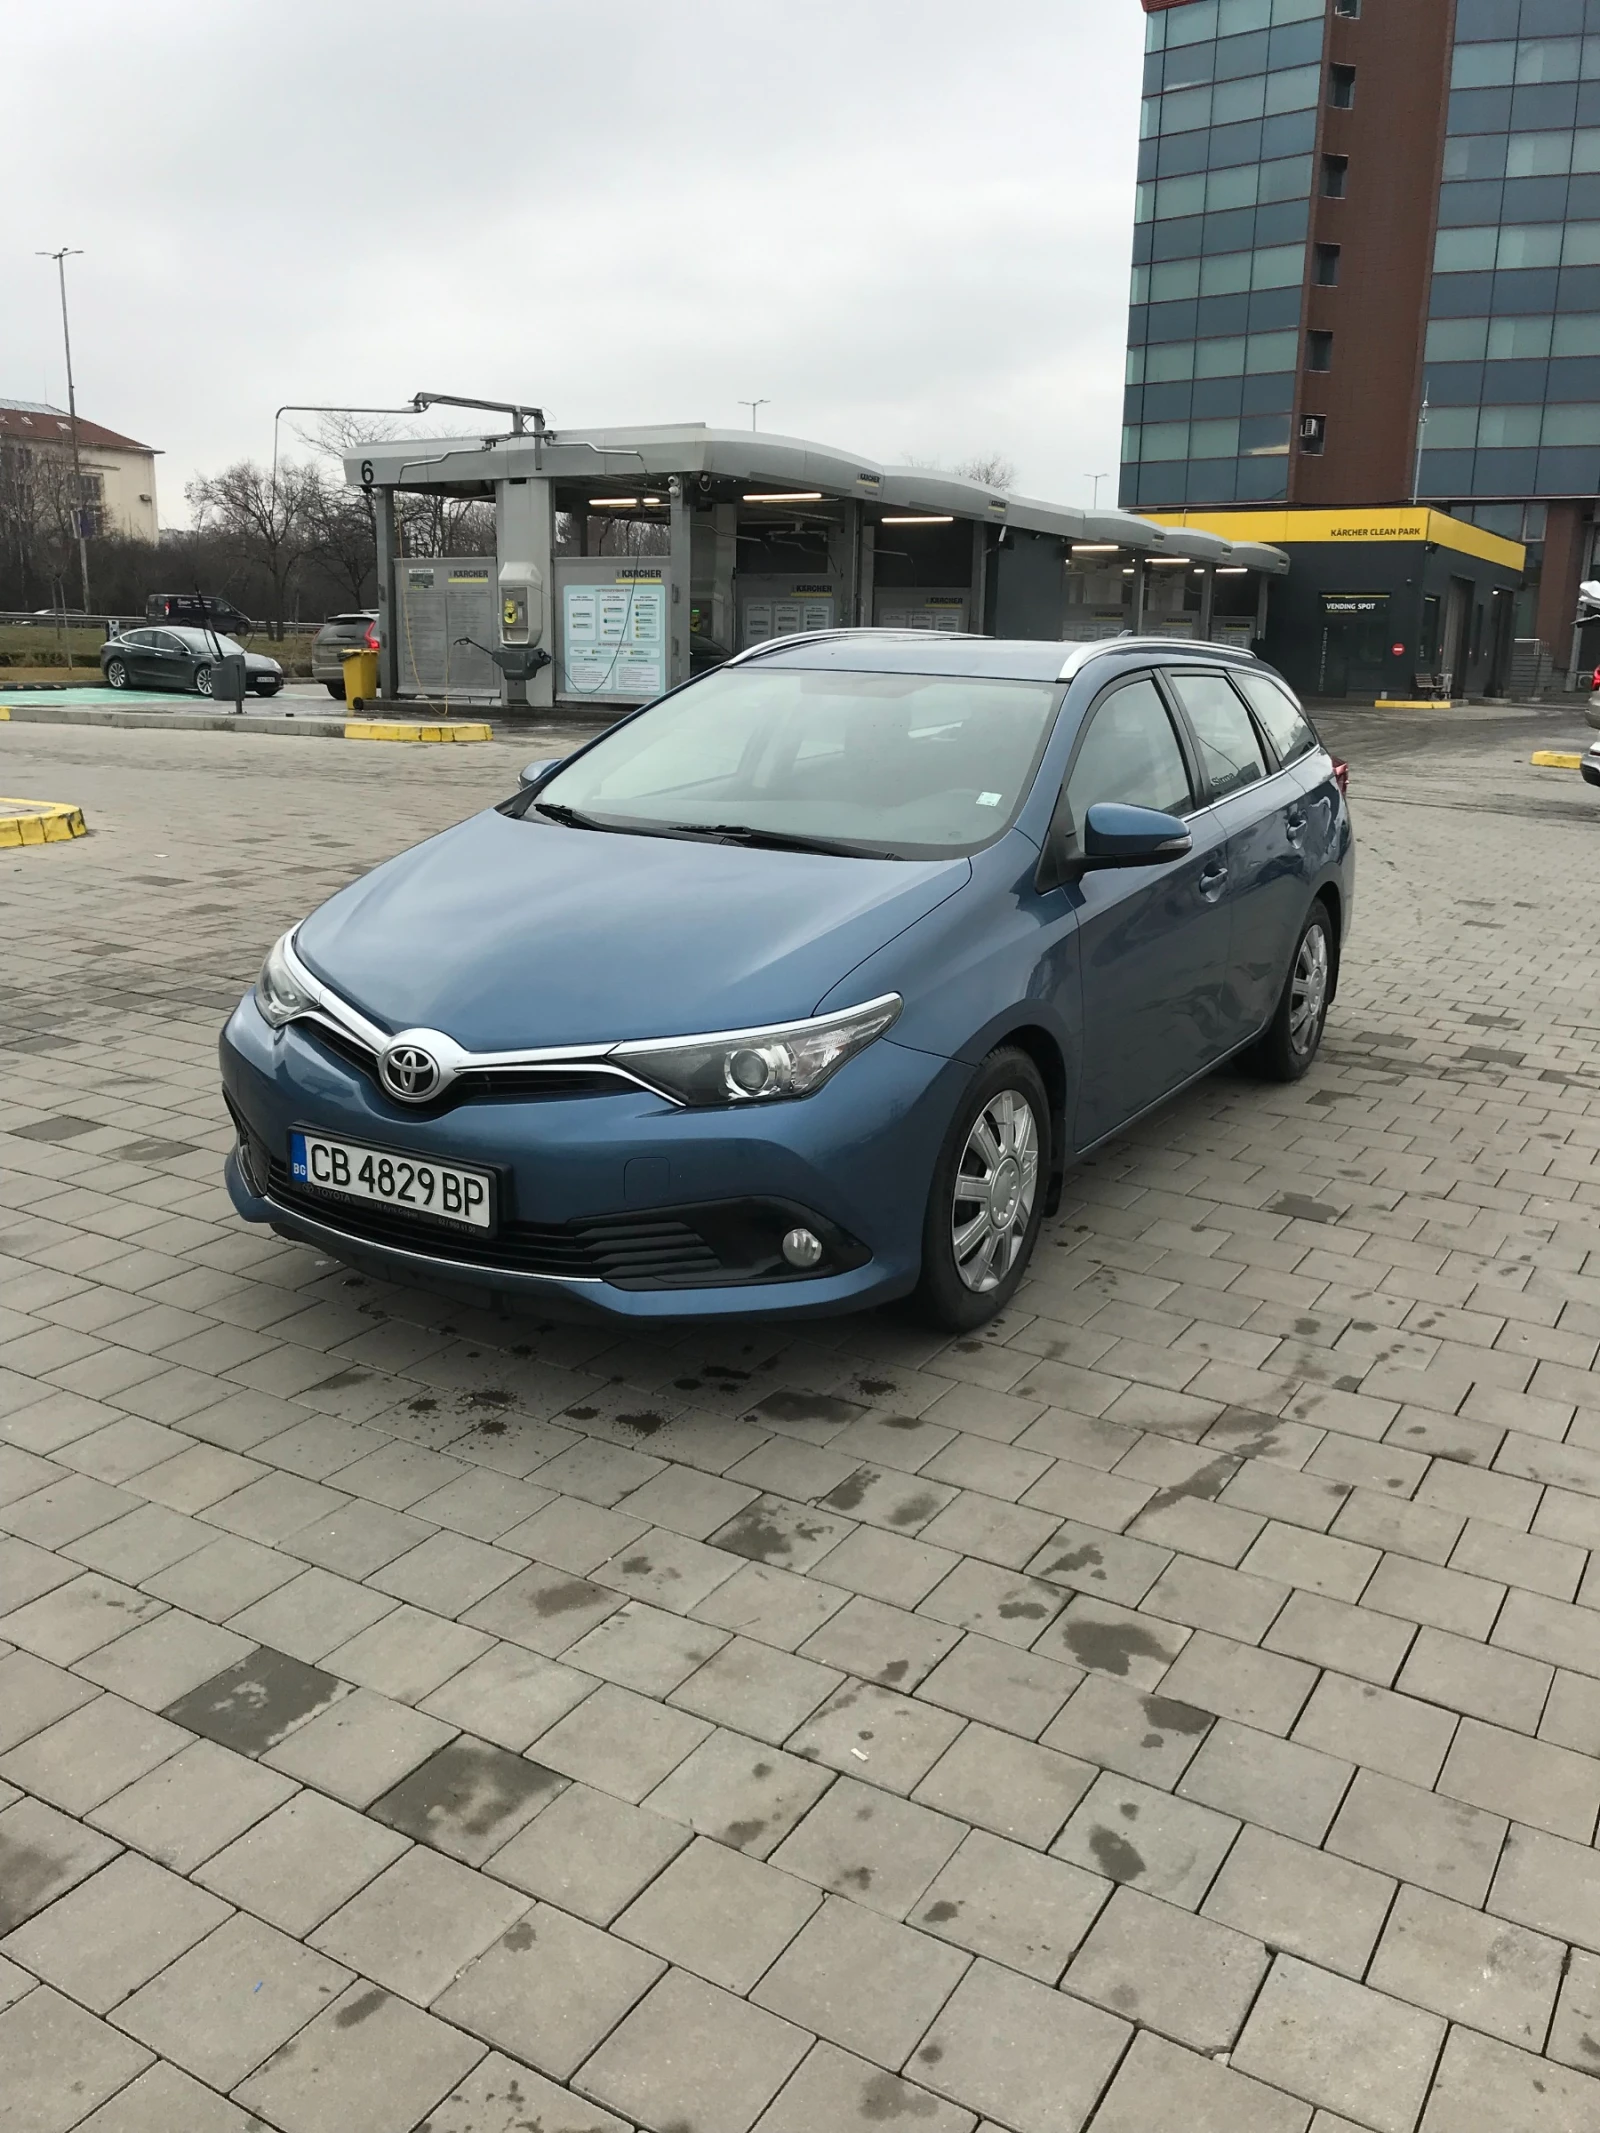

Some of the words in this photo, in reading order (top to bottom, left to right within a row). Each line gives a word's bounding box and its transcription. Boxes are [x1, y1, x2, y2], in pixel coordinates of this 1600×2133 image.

[361, 460, 374, 485] 6
[1330, 528, 1368, 536] KÄRCHER
[1370, 528, 1396, 536] CLEAN
[1398, 527, 1420, 535] PARK
[453, 569, 489, 578] KÄRCHER
[621, 569, 662, 578] KÄRCHER
[293, 1163, 306, 1176] BG
[311, 1143, 350, 1186] CB
[358, 1155, 435, 1205] 4829
[442, 1171, 484, 1217] BP
[316, 1186, 351, 1203] TOYOTA
